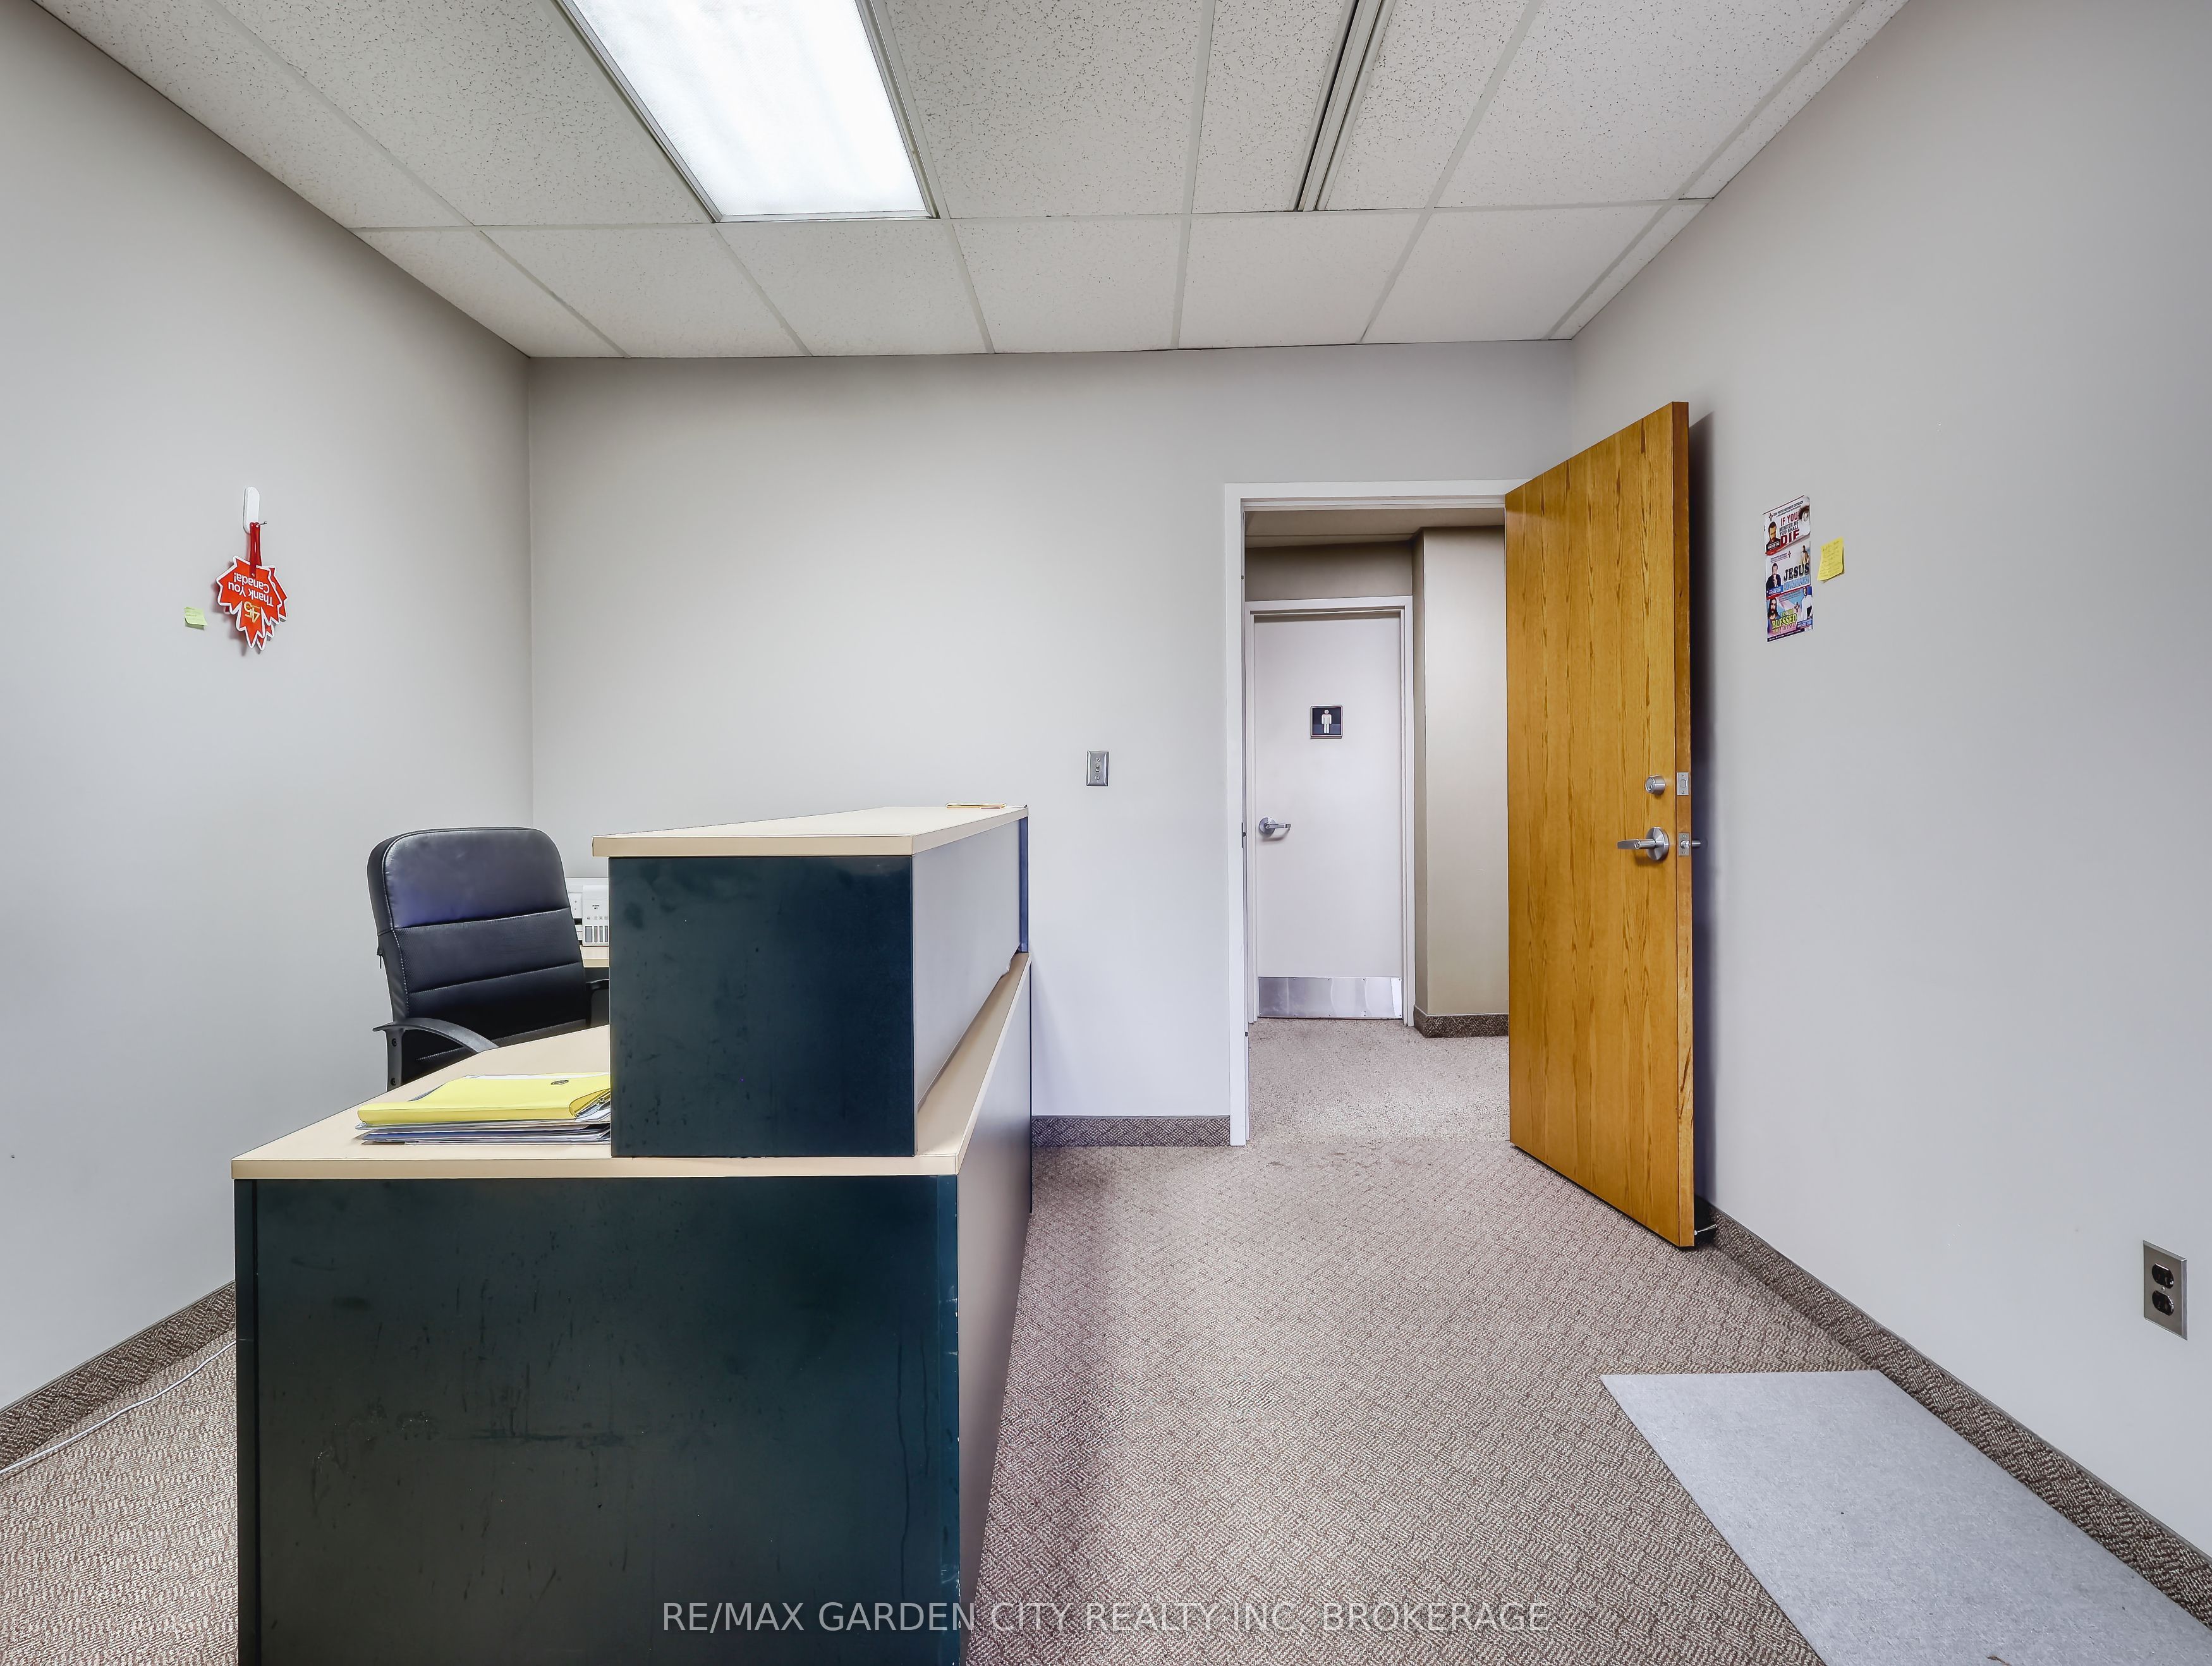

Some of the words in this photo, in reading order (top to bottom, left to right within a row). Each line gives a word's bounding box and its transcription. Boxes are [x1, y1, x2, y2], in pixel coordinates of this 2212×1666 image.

[1780, 523, 1793, 532] MONITOR
[1781, 517, 1786, 526] IF
[1787, 512, 1798, 523] YOU
[1784, 563, 1809, 581] JESUS
[228, 581, 246, 597] You
[234, 572, 270, 593] Canada!
[248, 588, 274, 607] Thank
[243, 601, 261, 623] 45
[1772, 614, 1797, 629] BLESSED
